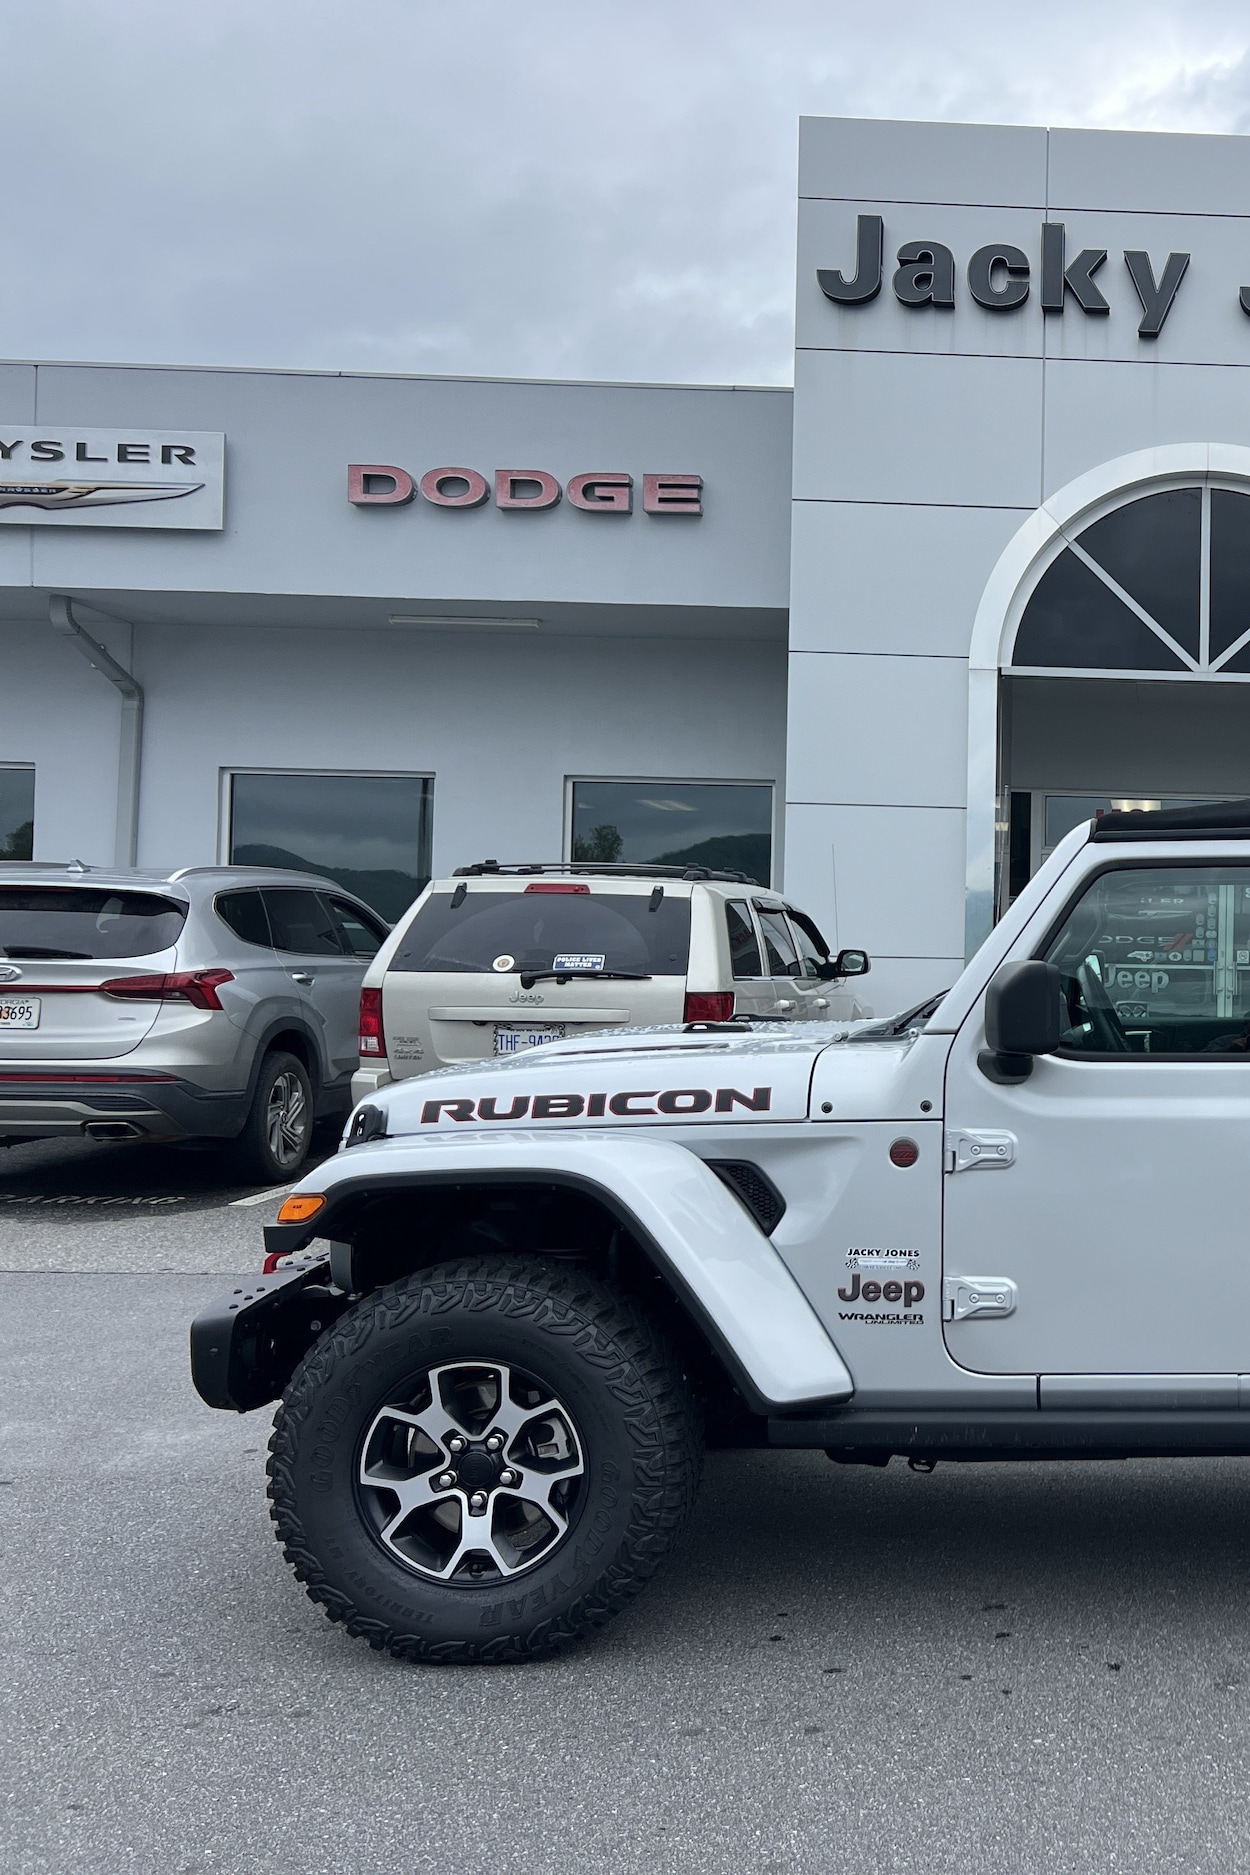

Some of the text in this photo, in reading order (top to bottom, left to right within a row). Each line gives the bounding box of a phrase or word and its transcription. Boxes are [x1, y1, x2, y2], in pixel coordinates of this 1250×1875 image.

[816, 214, 1191, 337] Jacky
[347, 463, 704, 517] DODGE
[1104, 965, 1170, 995] Jeep
[509, 990, 545, 1005] Jeep
[497, 1034, 560, 1051] THF-94
[420, 1086, 773, 1124] RUBICON
[847, 1248, 920, 1257] JACKY JONES
[837, 1273, 925, 1308] Jeep
[838, 1312, 924, 1321] WRANGLER
